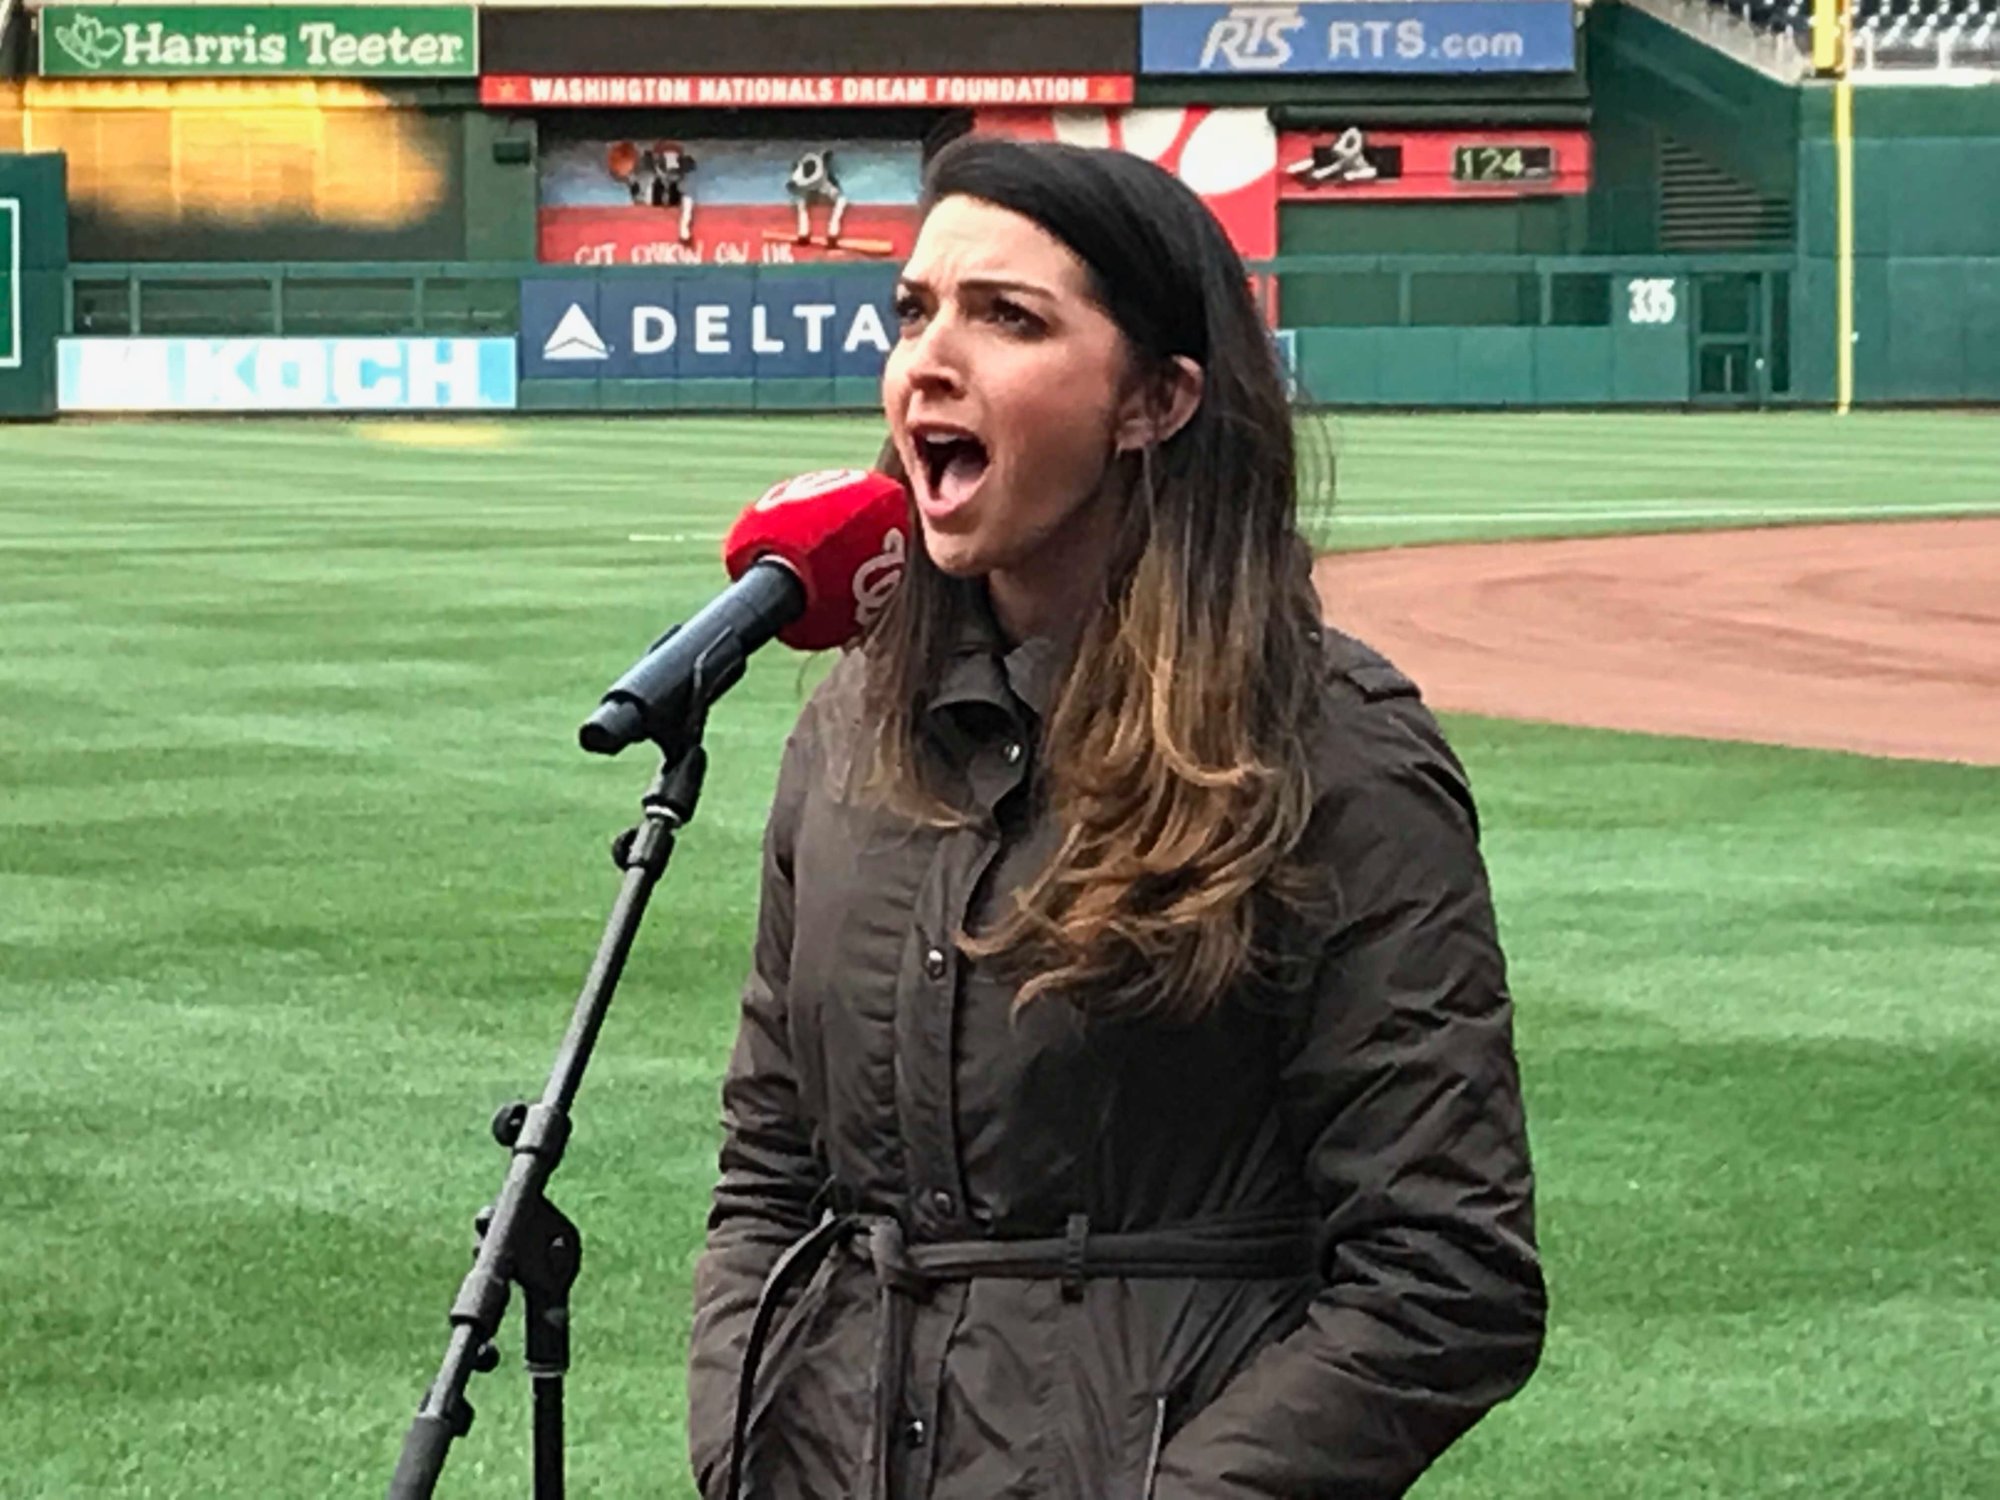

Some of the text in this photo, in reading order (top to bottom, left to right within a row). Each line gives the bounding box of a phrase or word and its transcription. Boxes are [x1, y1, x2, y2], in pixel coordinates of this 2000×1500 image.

[122, 22, 463, 66] Harris Teeter
[1200, 6, 1524, 69] RTS RTS.com
[530, 78, 1088, 102] WASHINGTON NATIONALS DREAM FOUNDATION
[1462, 149, 1524, 179] 124
[1627, 278, 1676, 323] 335
[632, 304, 891, 353] DELTA
[189, 340, 475, 404] KOCH
